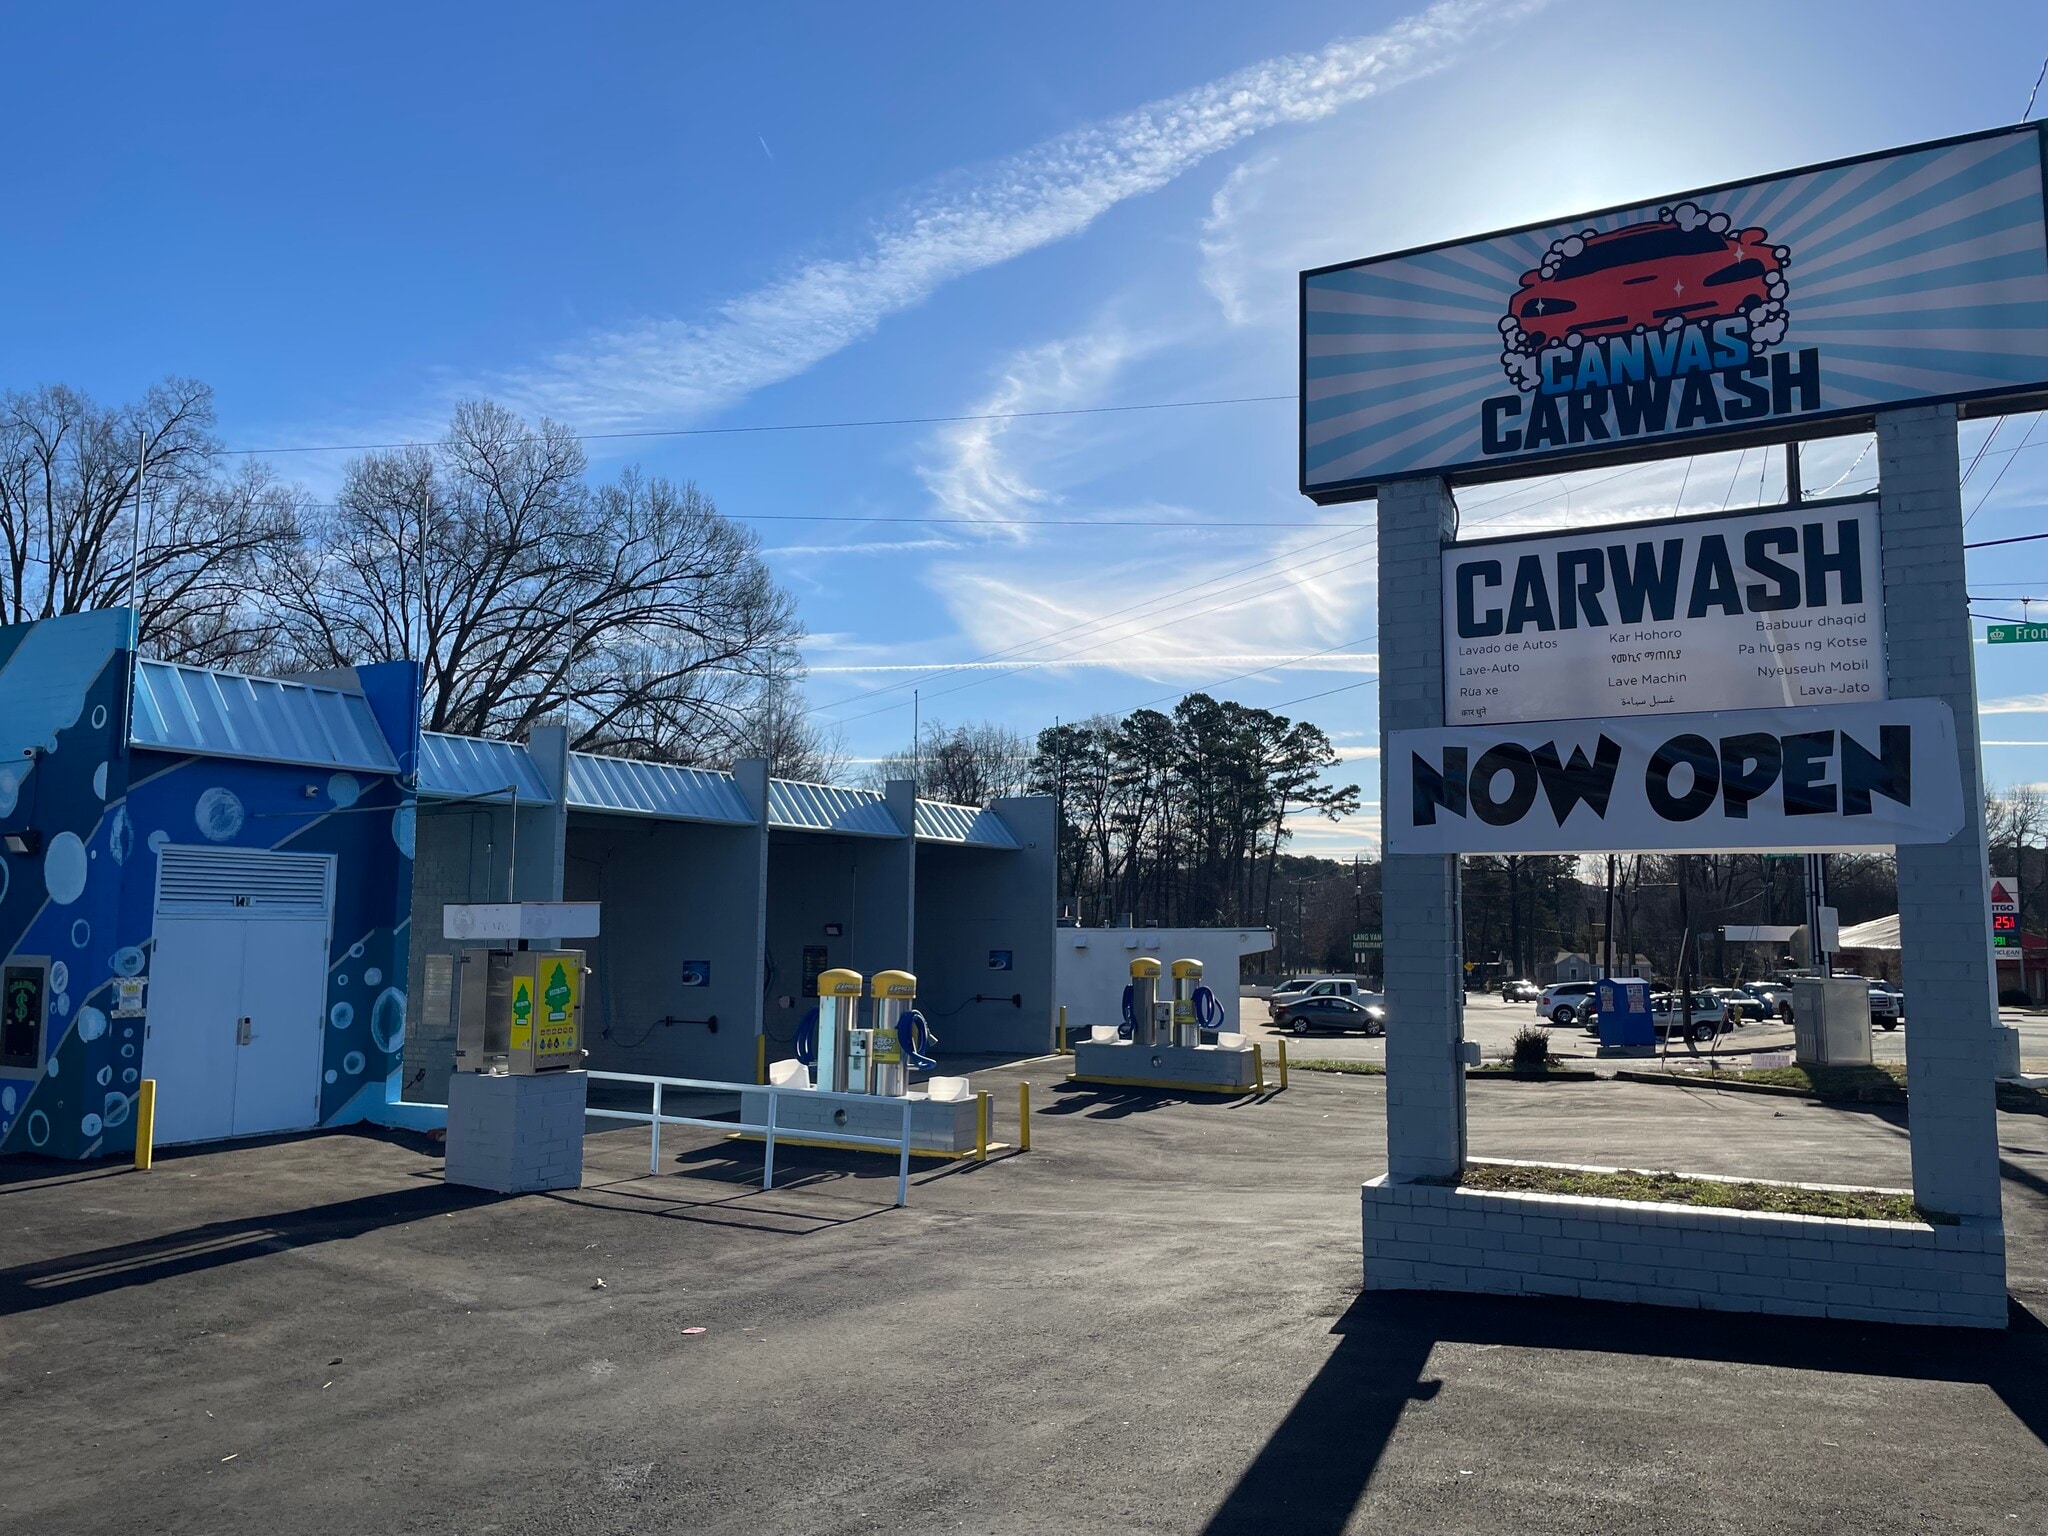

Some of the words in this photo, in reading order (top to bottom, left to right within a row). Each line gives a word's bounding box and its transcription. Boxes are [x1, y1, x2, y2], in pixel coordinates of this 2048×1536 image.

[1540, 316, 1749, 396] CANVAS
[1481, 347, 1821, 455] CARWASH
[1456, 518, 1863, 639] CARWASH
[1756, 617, 1813, 632] Baabuur
[1817, 612, 1866, 627] dhaqid
[1609, 632, 1630, 643] Kar
[1634, 629, 1682, 641] Hohoro
[1458, 643, 1501, 656] Lavado
[1504, 641, 1519, 652] de
[1522, 639, 1558, 651] Autos
[1738, 643, 1755, 655] Pa
[1759, 640, 1800, 654] hugas
[1804, 639, 1822, 652] ng
[1827, 636, 1868, 649] Kotse
[1459, 663, 1520, 676] Lave-Auto
[1757, 661, 1825, 678] Nyeuseuh
[1830, 658, 1869, 672] Mobil
[1608, 676, 1638, 687] Lave
[1641, 671, 1687, 685] Machin
[1485, 686, 1499, 696] xe
[1799, 681, 1870, 696] Lava-Jato
[1461, 708, 1475, 718] कार
[1411, 732, 1623, 829] NOW
[1644, 724, 1913, 823] OPEN
